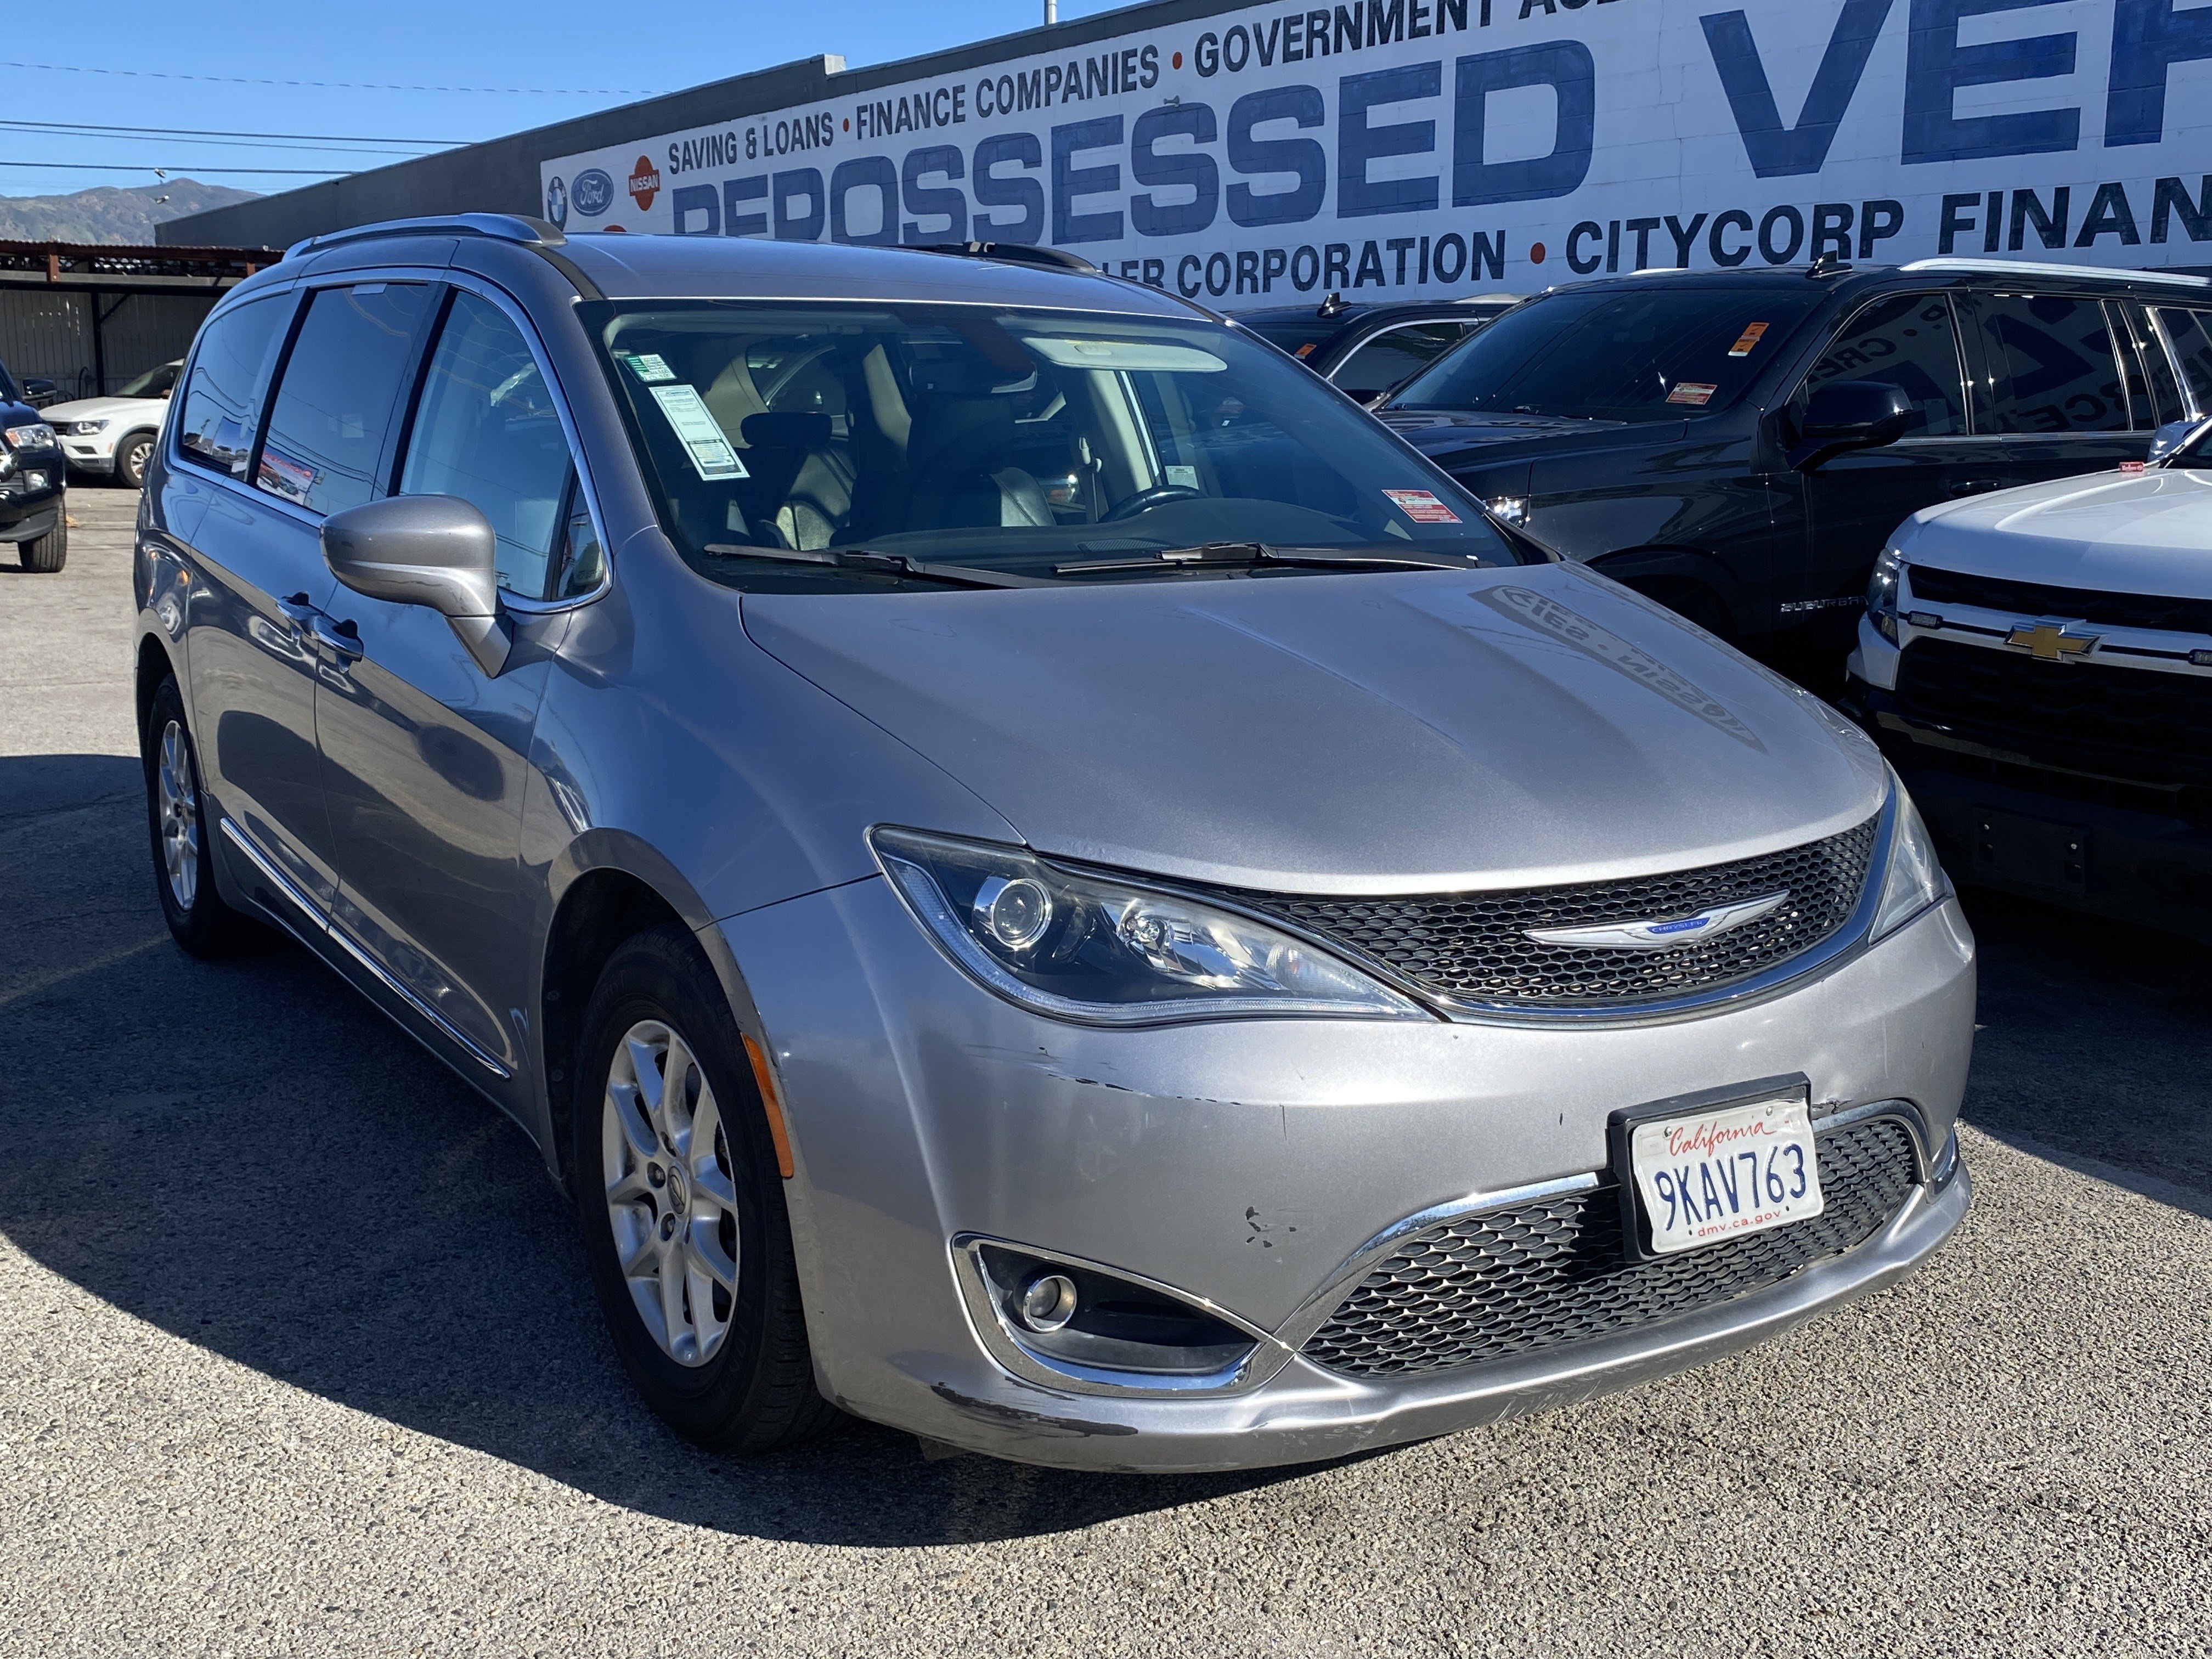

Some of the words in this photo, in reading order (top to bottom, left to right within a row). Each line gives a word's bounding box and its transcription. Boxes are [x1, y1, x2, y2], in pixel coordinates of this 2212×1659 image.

[669, 132, 737, 174] SAVING
[746, 127, 757, 159] &
[764, 114, 834, 156] LOANS
[856, 84, 966, 139] FINANCE
[976, 44, 1159, 118] COMPANIES
[580, 179, 604, 206] Ford
[631, 174, 659, 193] NISSAN
[1178, 230, 1506, 298] CORPORATION
[1566, 199, 1904, 275] CITYCORP
[1652, 921, 1702, 933] CHRYSLER
[1669, 1120, 1777, 1157] California
[1655, 1143, 1806, 1232] 9KAV763
[1698, 1209, 1781, 1237] dmv.ca.gov
